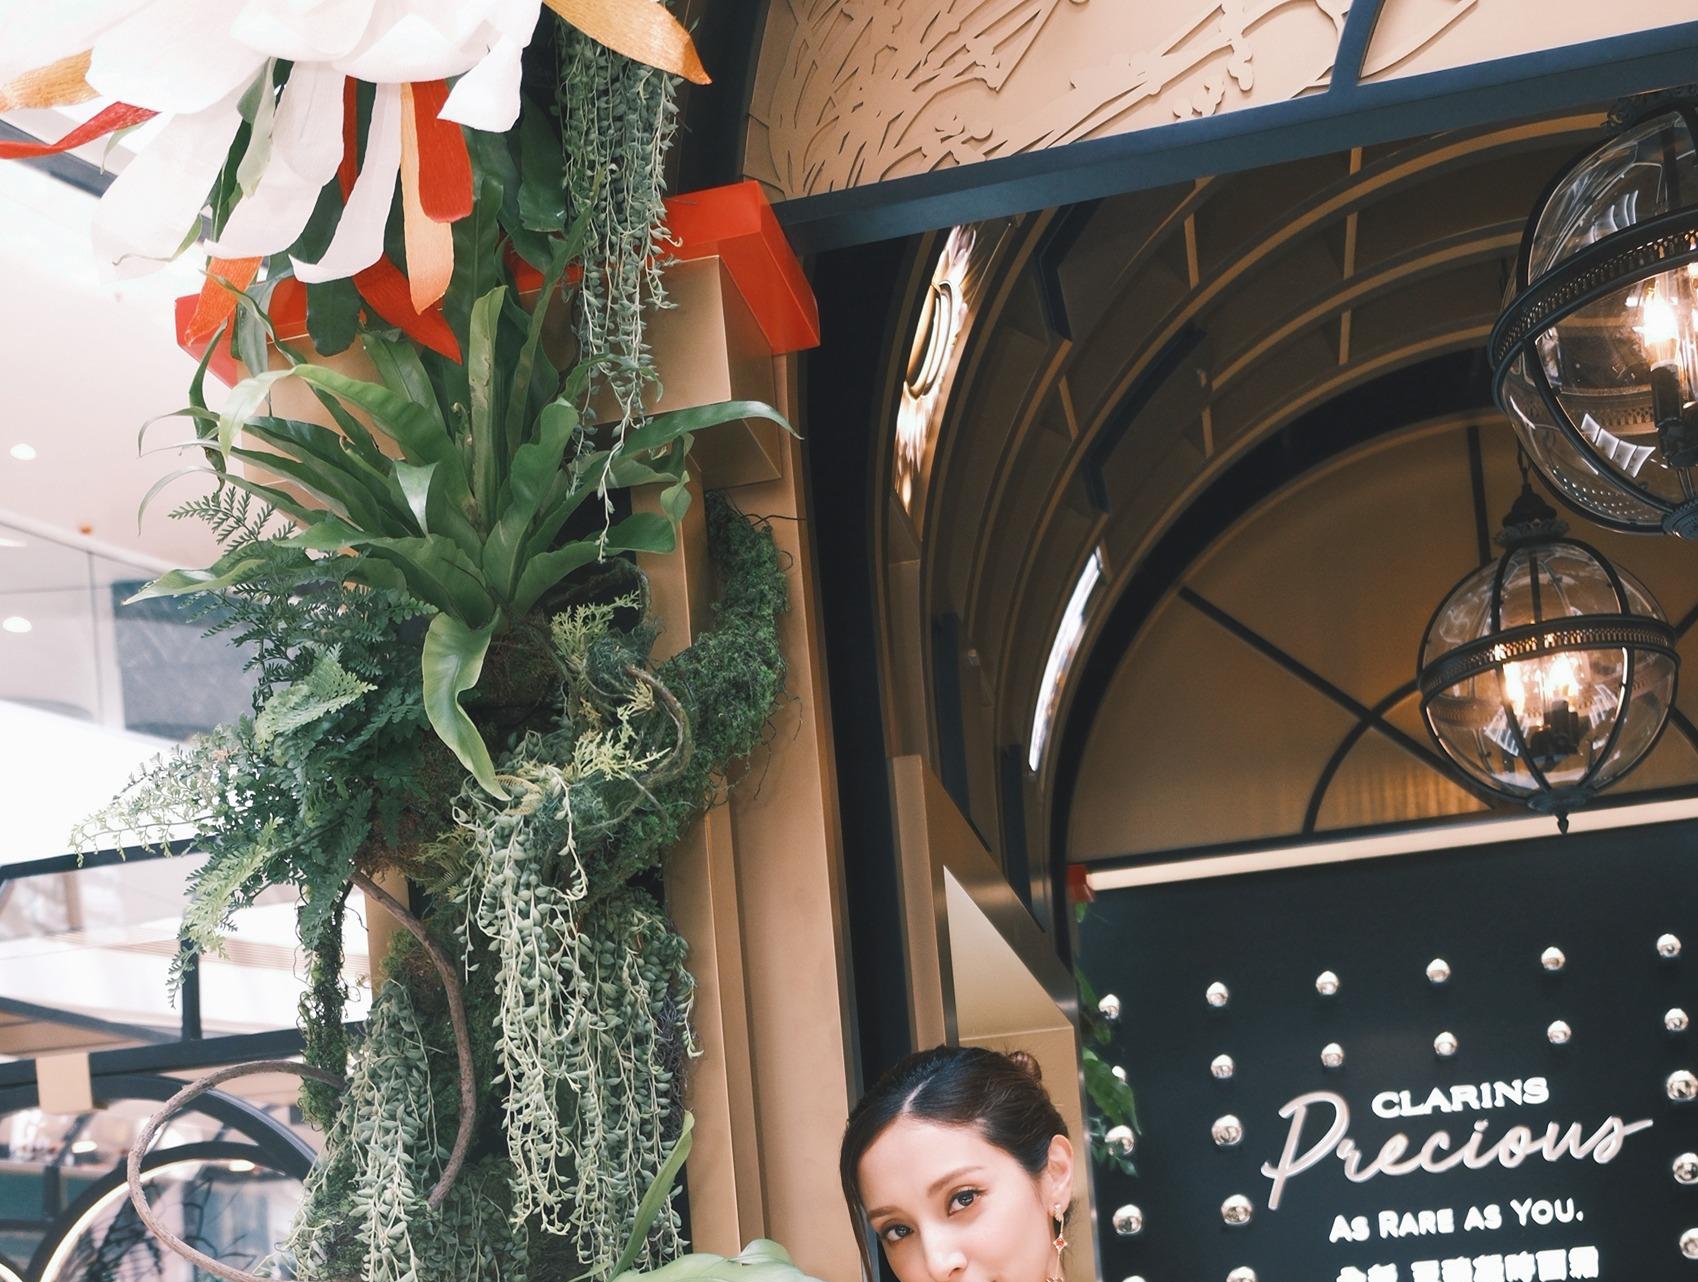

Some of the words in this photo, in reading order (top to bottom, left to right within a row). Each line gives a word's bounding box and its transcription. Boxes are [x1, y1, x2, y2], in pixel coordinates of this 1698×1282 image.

[1371, 1076, 1550, 1119] CLARINS
[1260, 1091, 1654, 1211] Precious
[1328, 1214, 1371, 1244] AS
[1377, 1207, 1455, 1239] RARE
[1463, 1203, 1503, 1232] AS
[1509, 1197, 1584, 1227] YOU.
